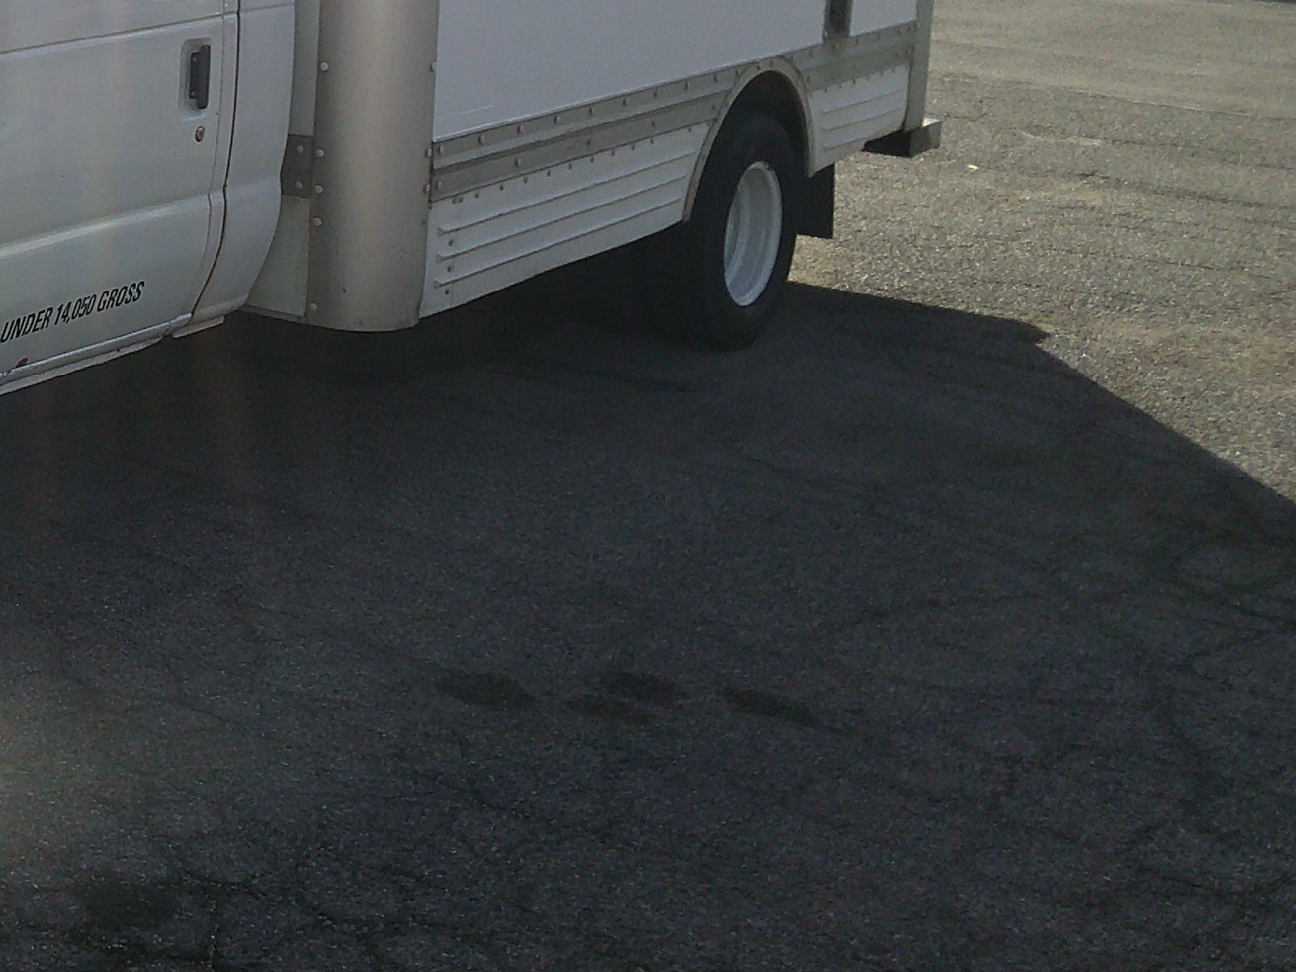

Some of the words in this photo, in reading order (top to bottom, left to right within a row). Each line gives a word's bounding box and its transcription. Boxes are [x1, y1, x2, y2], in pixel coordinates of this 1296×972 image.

[0, 307, 54, 343] UNDER
[54, 293, 97, 326] 14,050
[97, 280, 145, 312] GROSS
